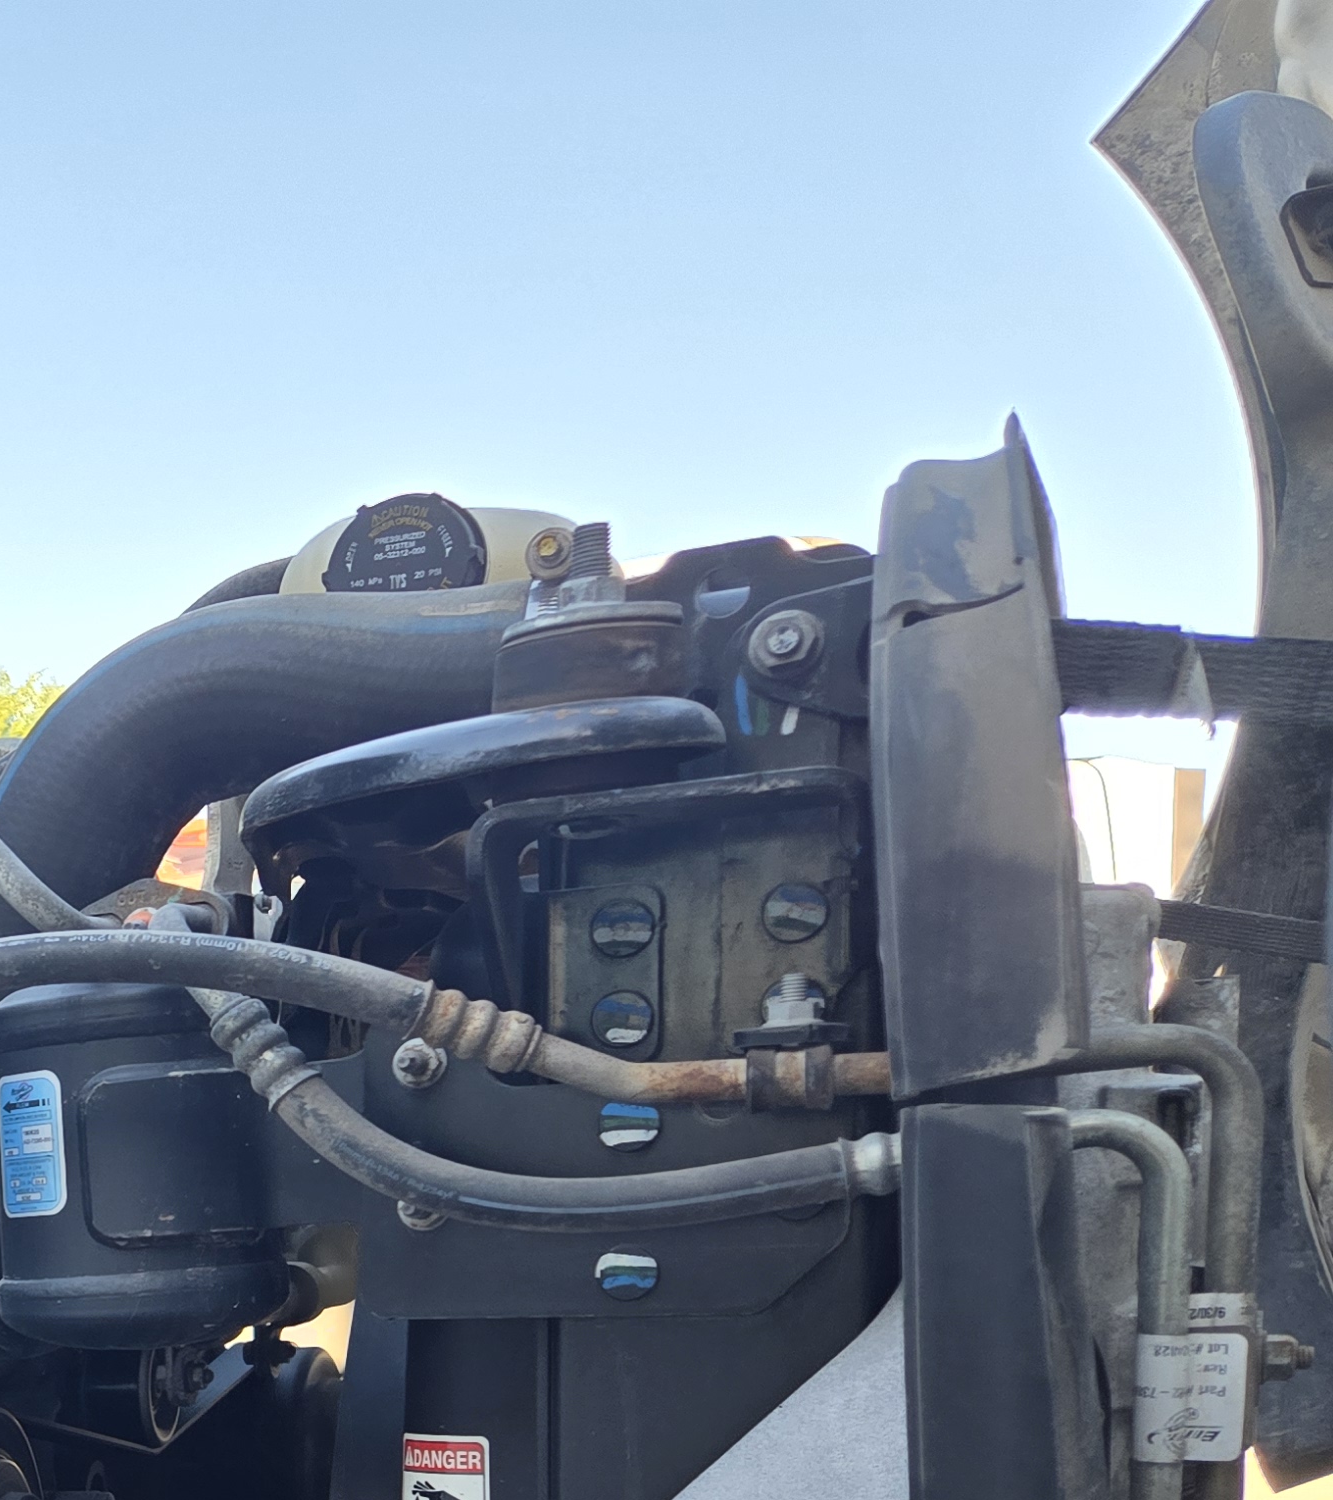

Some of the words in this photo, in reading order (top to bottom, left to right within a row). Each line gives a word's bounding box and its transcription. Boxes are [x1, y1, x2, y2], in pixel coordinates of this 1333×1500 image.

[382, 504, 430, 519] CAUTION
[374, 531, 426, 545] PRESSURIZED
[385, 541, 416, 551] SYSTEM
[414, 571, 425, 580] 20
[428, 568, 442, 577] PSI
[414, 1448, 482, 1470] DANGER
